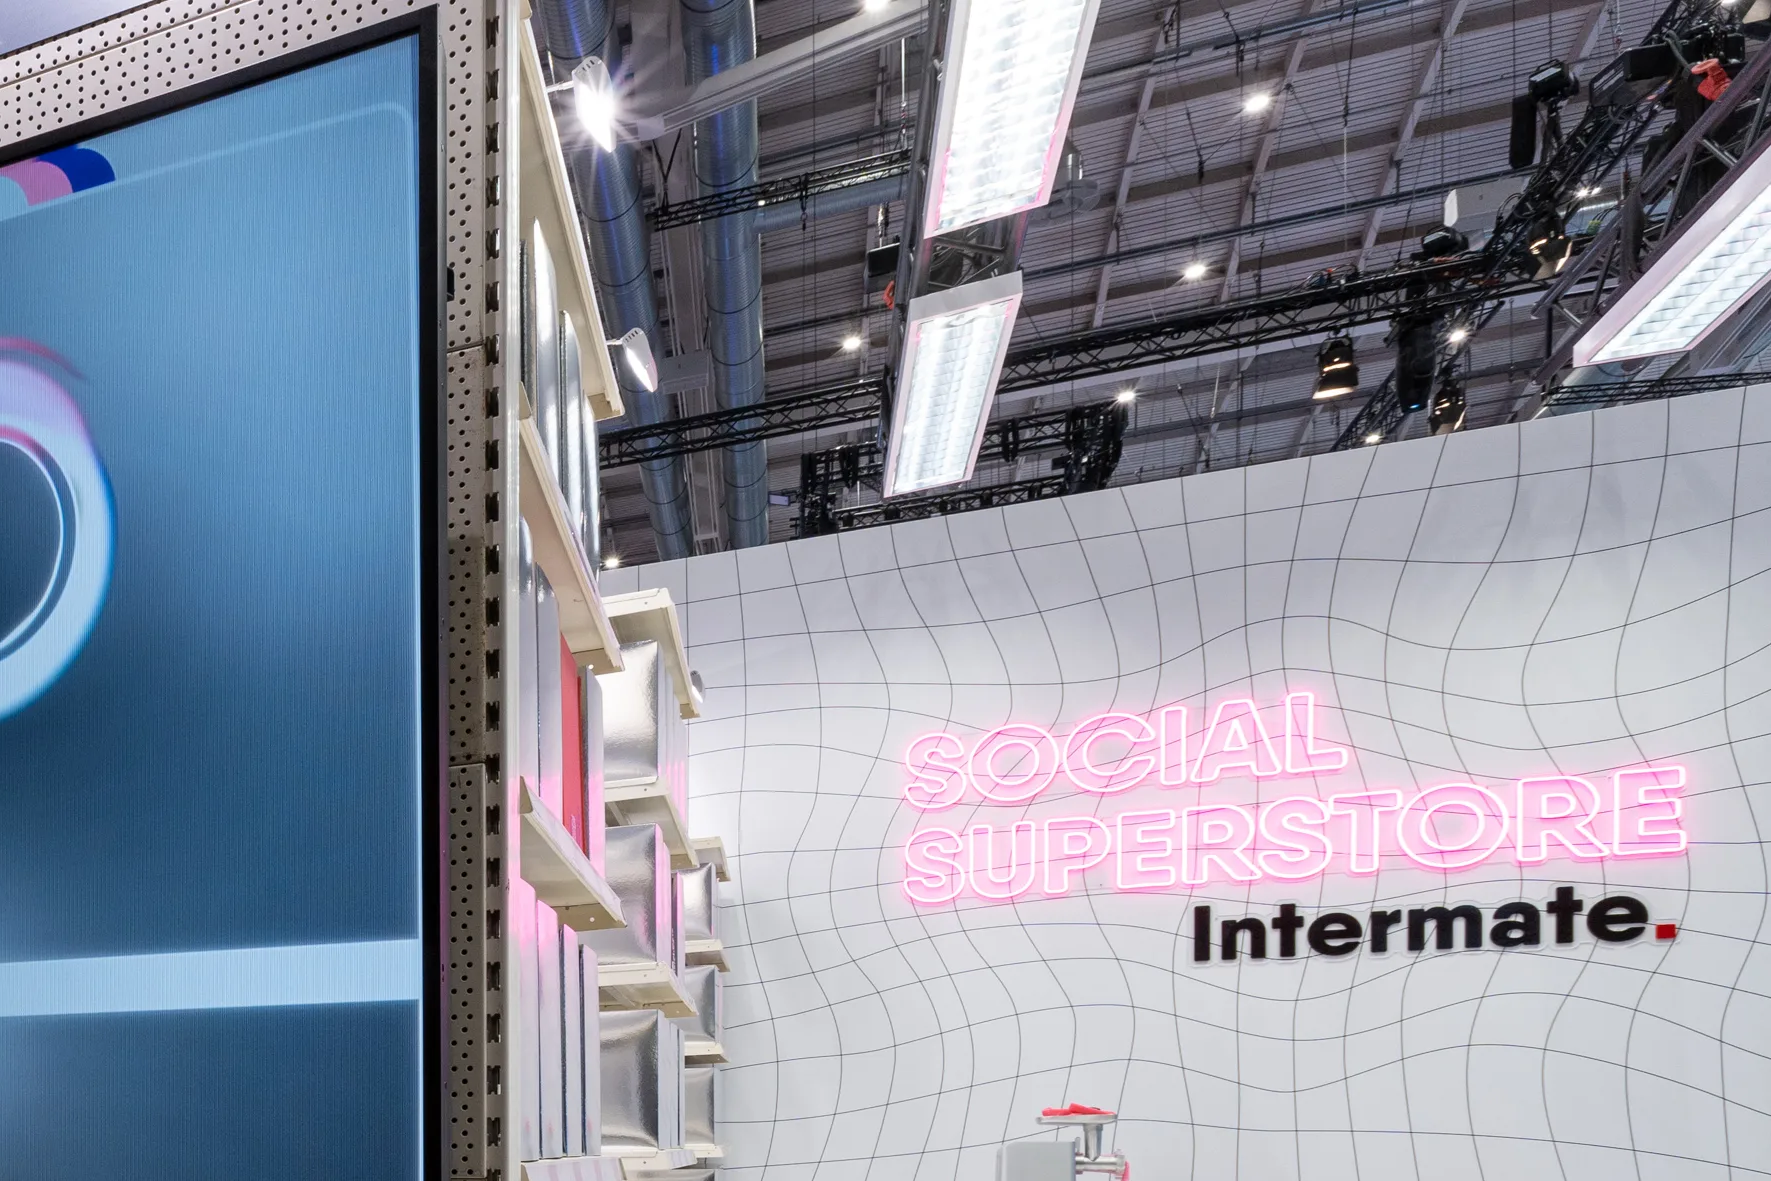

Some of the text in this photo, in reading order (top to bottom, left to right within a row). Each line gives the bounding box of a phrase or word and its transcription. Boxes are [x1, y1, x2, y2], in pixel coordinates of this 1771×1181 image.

[902, 691, 1349, 810] SOCIAL
[901, 765, 1690, 904] SUPERSTORE
[1192, 886, 1677, 962] Intermate.
